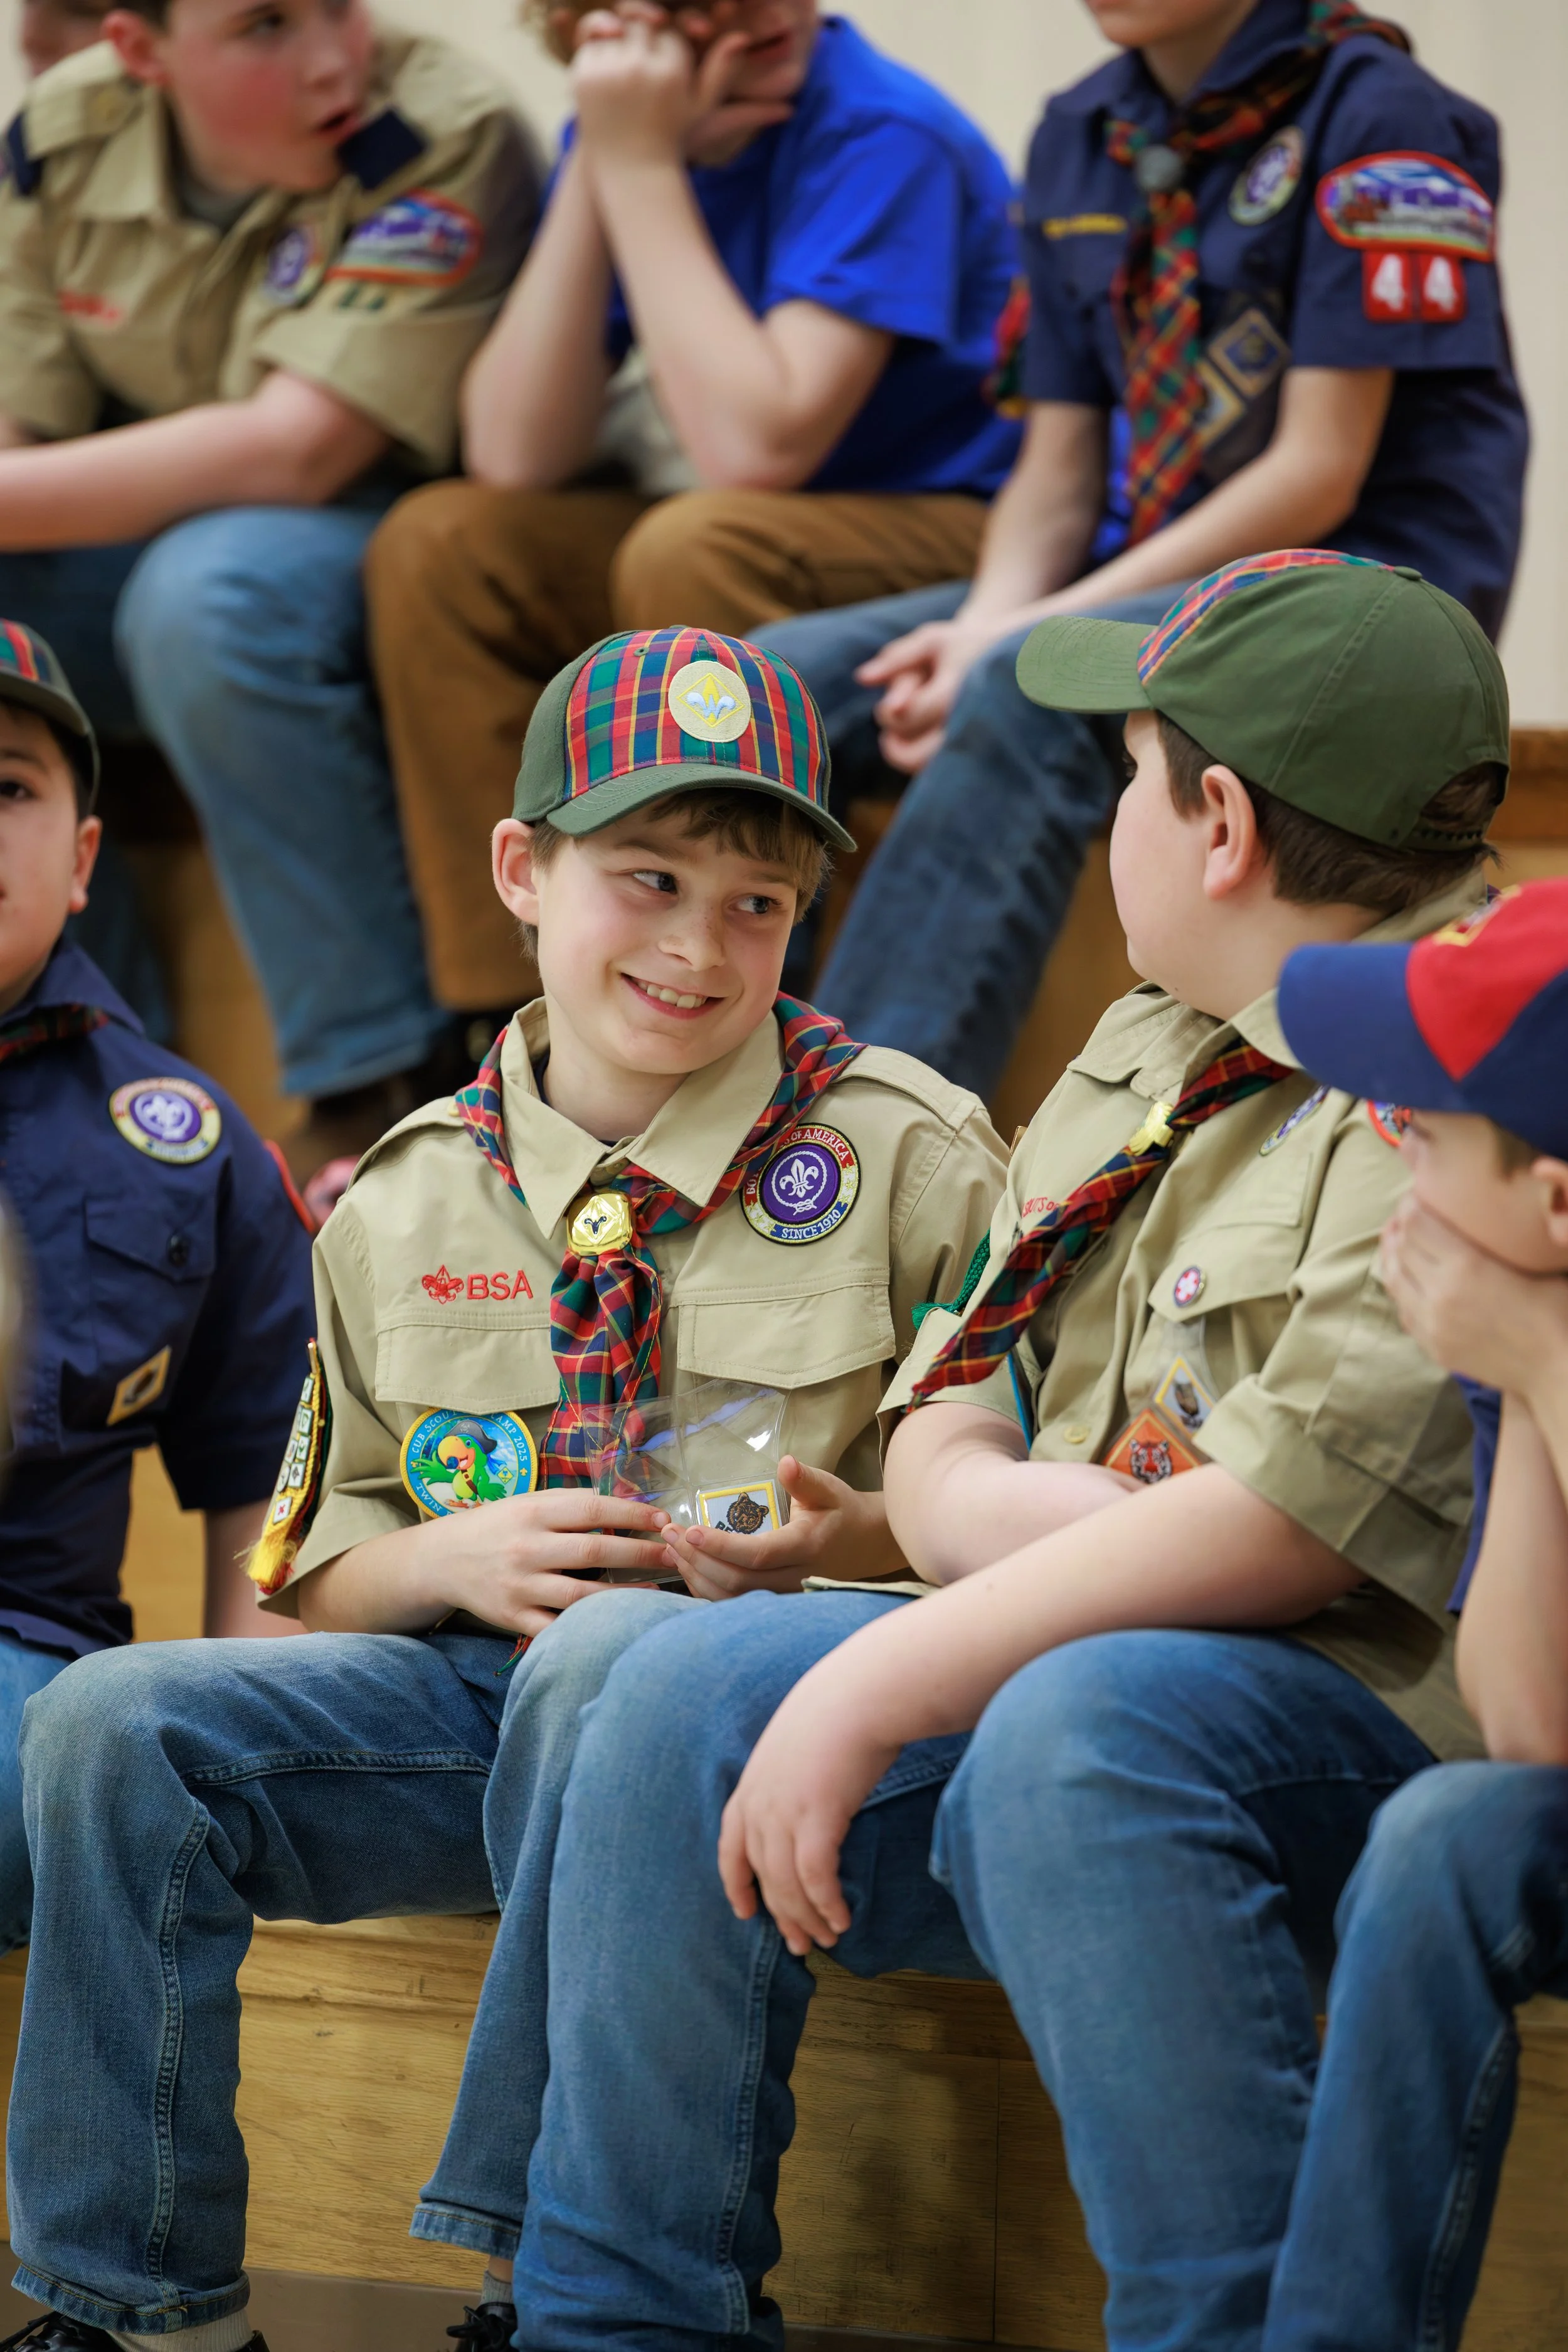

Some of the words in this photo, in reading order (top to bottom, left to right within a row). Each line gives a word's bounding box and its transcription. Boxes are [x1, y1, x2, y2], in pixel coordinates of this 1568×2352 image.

[1371, 253, 1458, 312] 44
[802, 1128, 848, 1161] AMERICA
[781, 1226, 818, 1239] SINCE
[817, 1209, 842, 1233] 1910
[467, 1269, 533, 1300] BSA
[412, 1433, 425, 1453] CUB
[514, 1436, 527, 1461] 2025
[416, 1483, 442, 1512] TWIN
